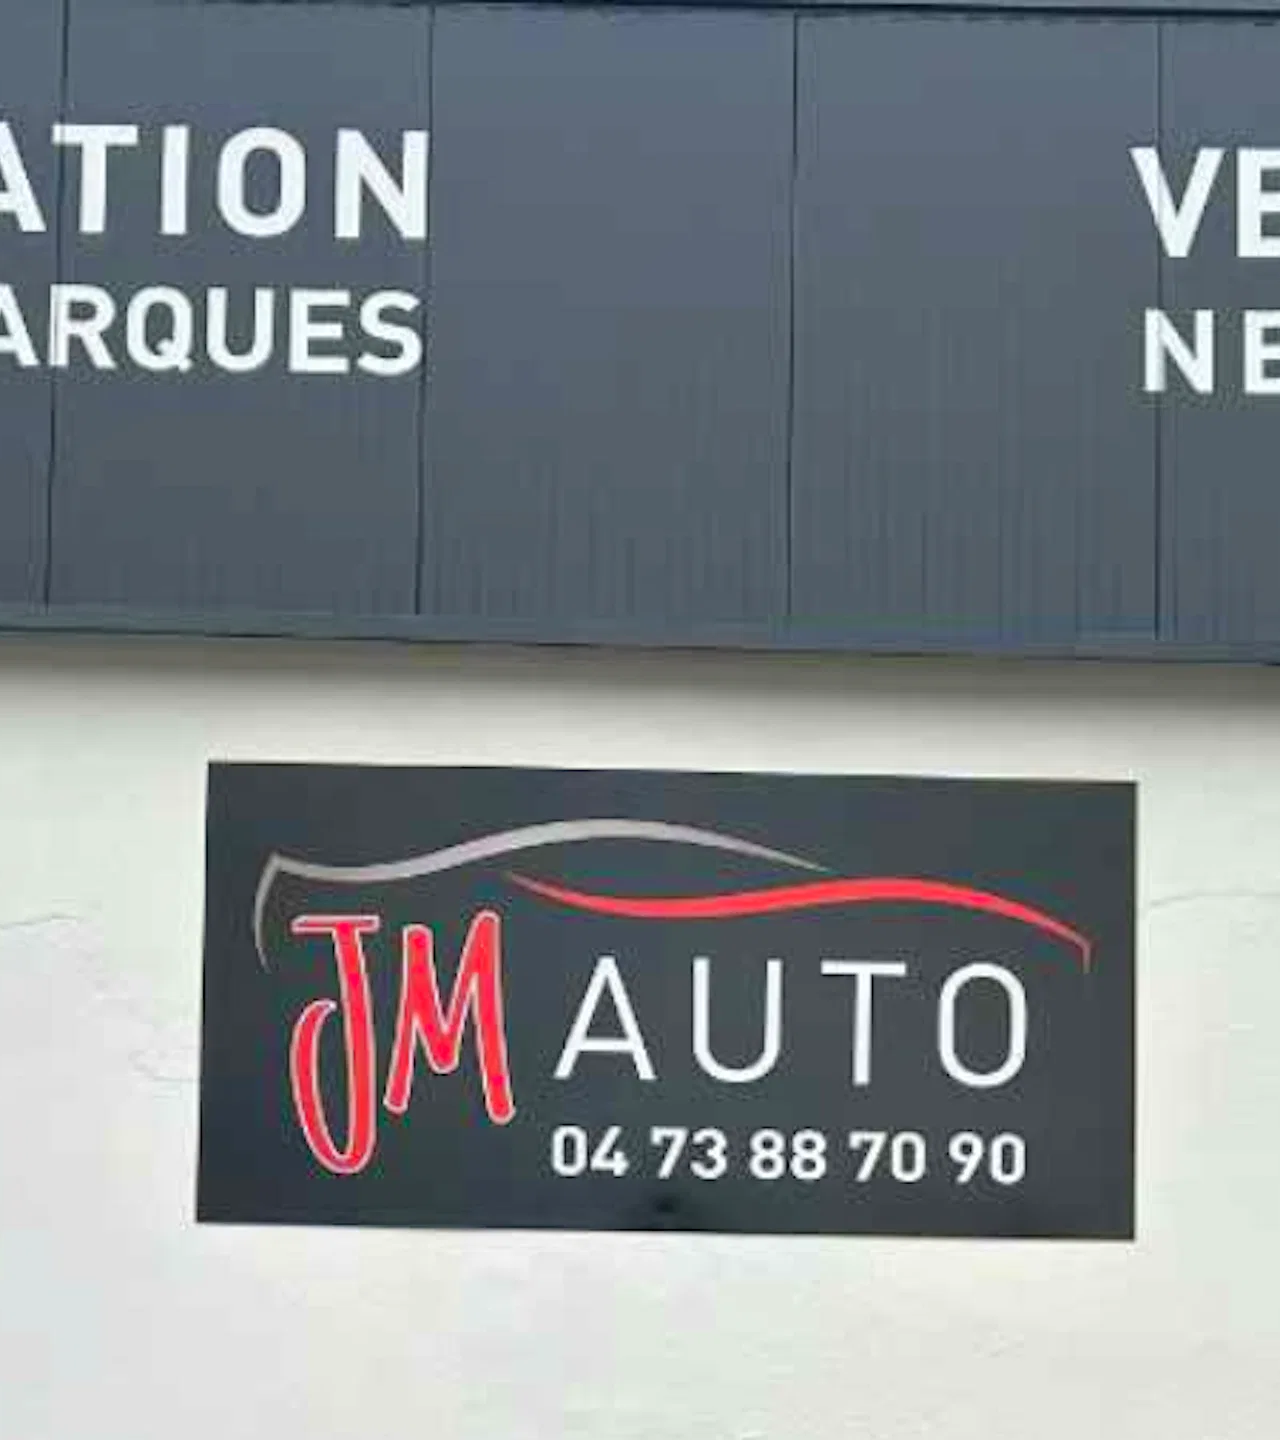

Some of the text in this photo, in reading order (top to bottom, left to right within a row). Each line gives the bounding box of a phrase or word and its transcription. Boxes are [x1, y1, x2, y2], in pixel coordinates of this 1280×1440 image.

[291, 909, 1029, 1174] JM AUTO
[550, 1125, 1026, 1185] 04 73 88 70 90
